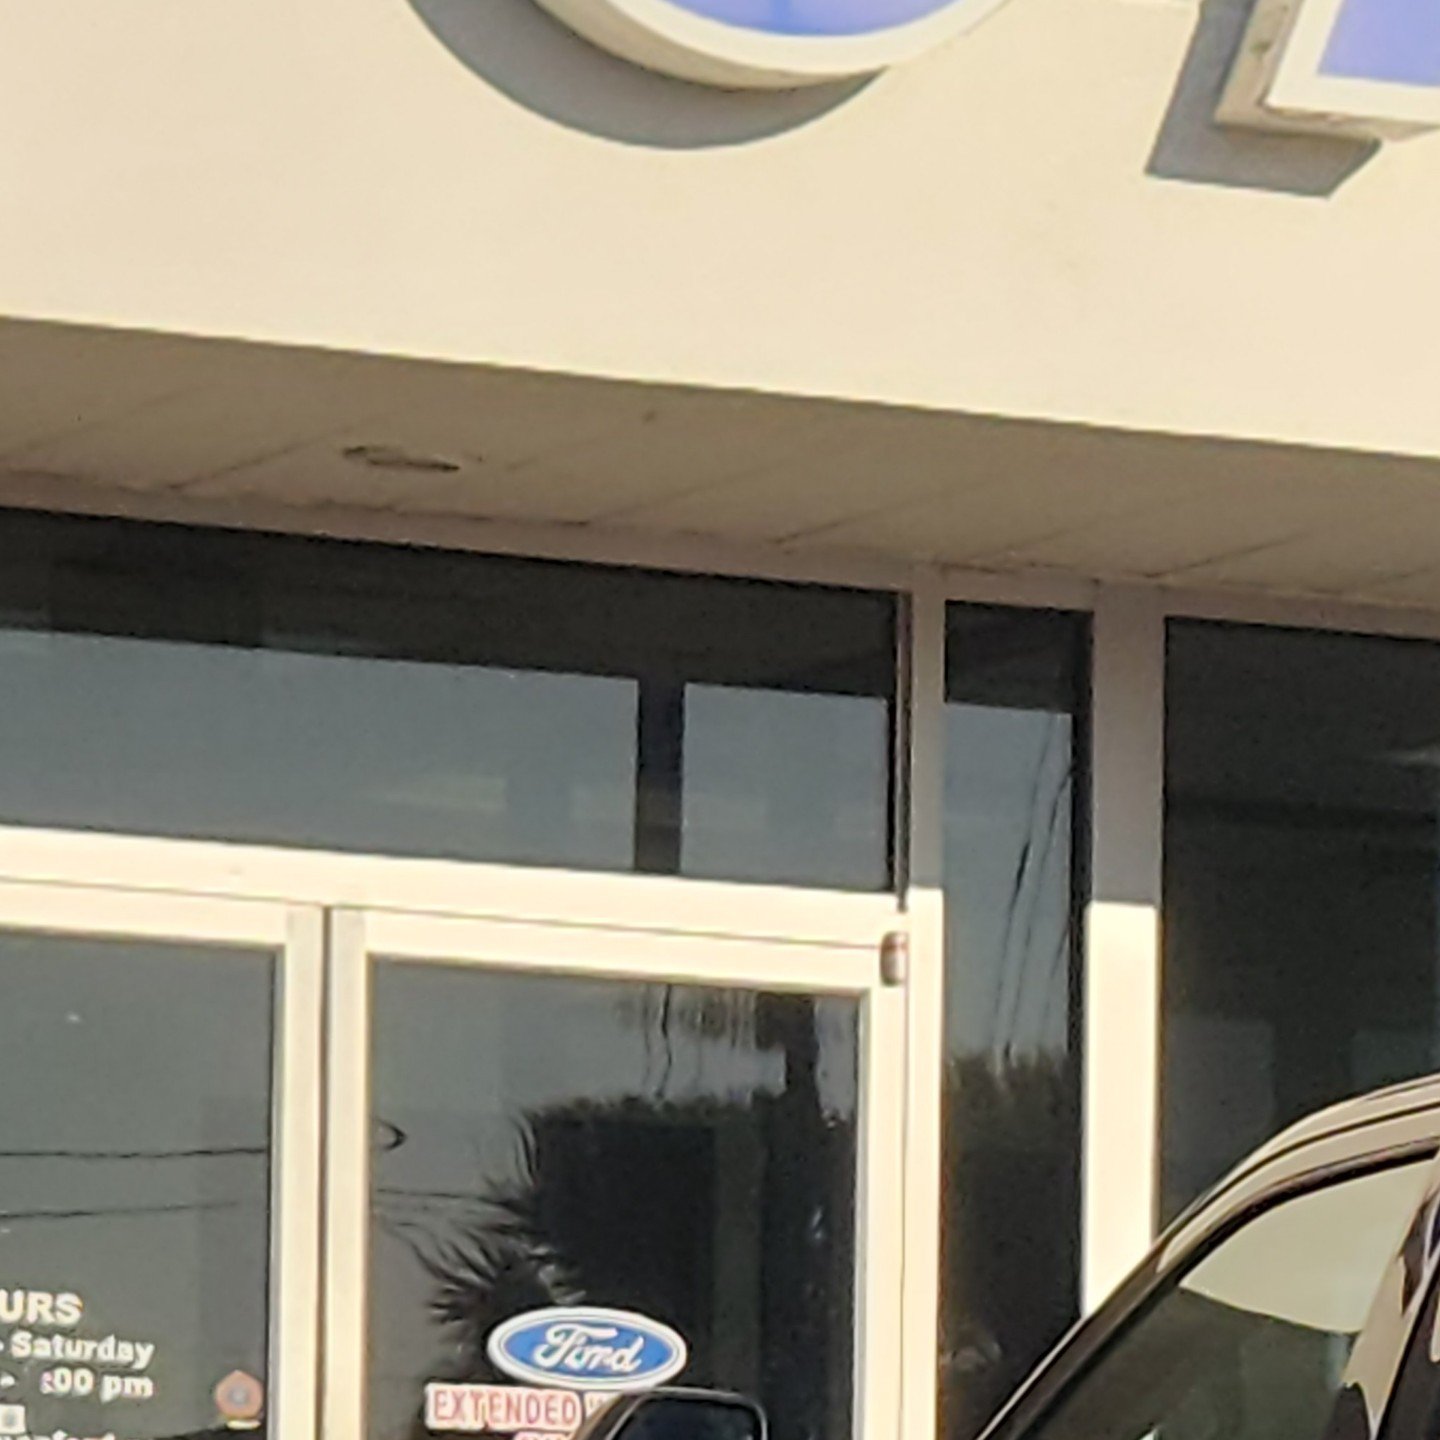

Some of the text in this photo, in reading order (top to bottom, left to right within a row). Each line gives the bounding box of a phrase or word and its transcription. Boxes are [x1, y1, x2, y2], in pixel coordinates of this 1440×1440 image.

[11, 1330, 155, 1370] Saturday
[533, 1323, 645, 1373] Ford
[101, 1374, 154, 1404] pm
[433, 1389, 577, 1426] EXTENDED
